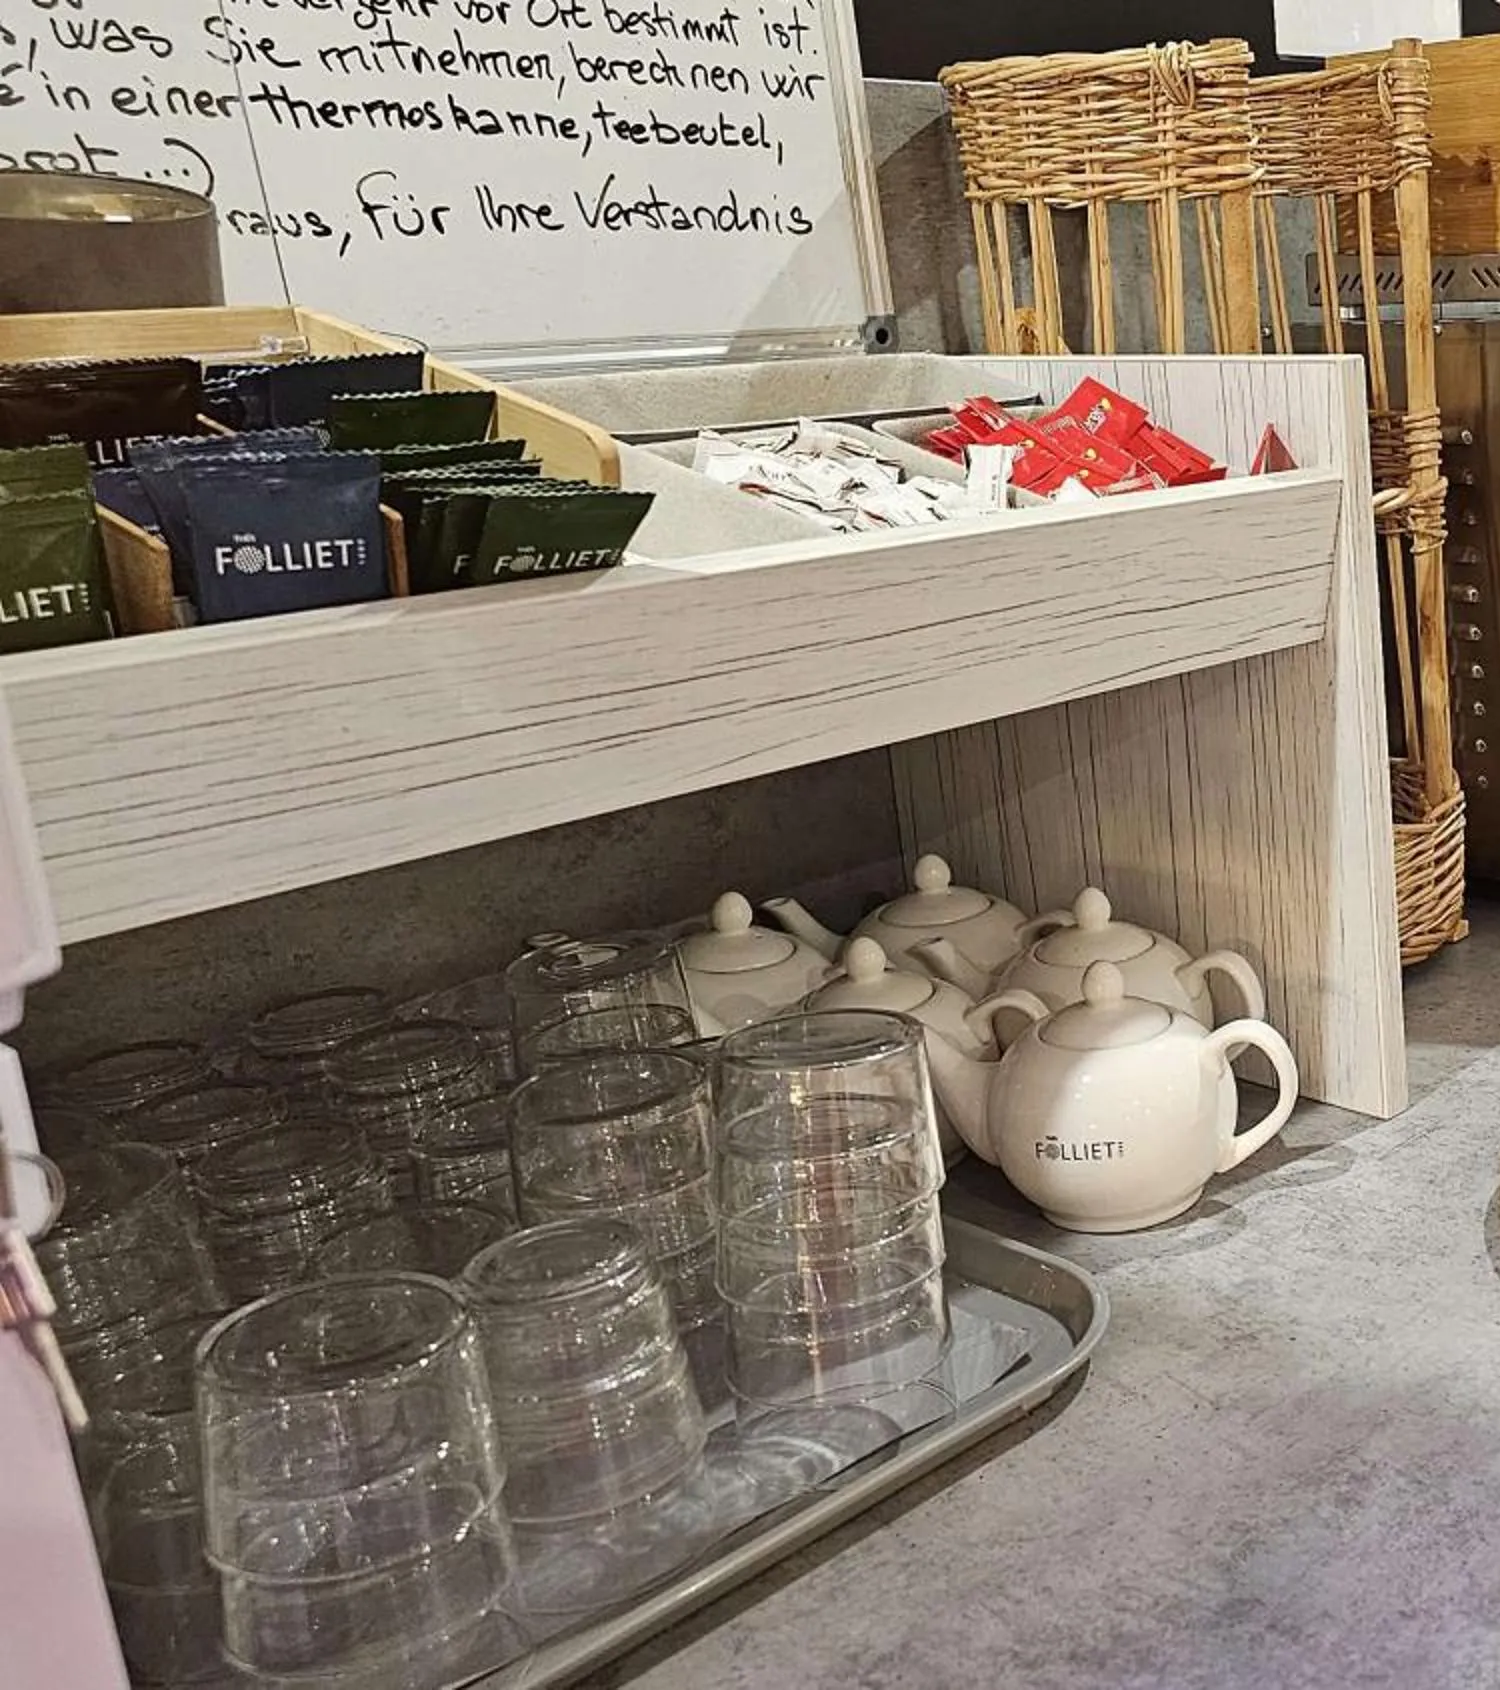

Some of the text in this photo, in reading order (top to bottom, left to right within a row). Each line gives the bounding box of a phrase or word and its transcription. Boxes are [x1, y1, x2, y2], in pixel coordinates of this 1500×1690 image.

[604, 1, 741, 47] bestimmt
[49, 17, 173, 58] was
[204, 15, 302, 67] Sie
[761, 63, 826, 101] wir
[40, 70, 91, 111] in
[111, 75, 243, 118] einer
[356, 170, 451, 241] für
[475, 184, 565, 233] Ihre
[574, 173, 814, 235] Verstandnis
